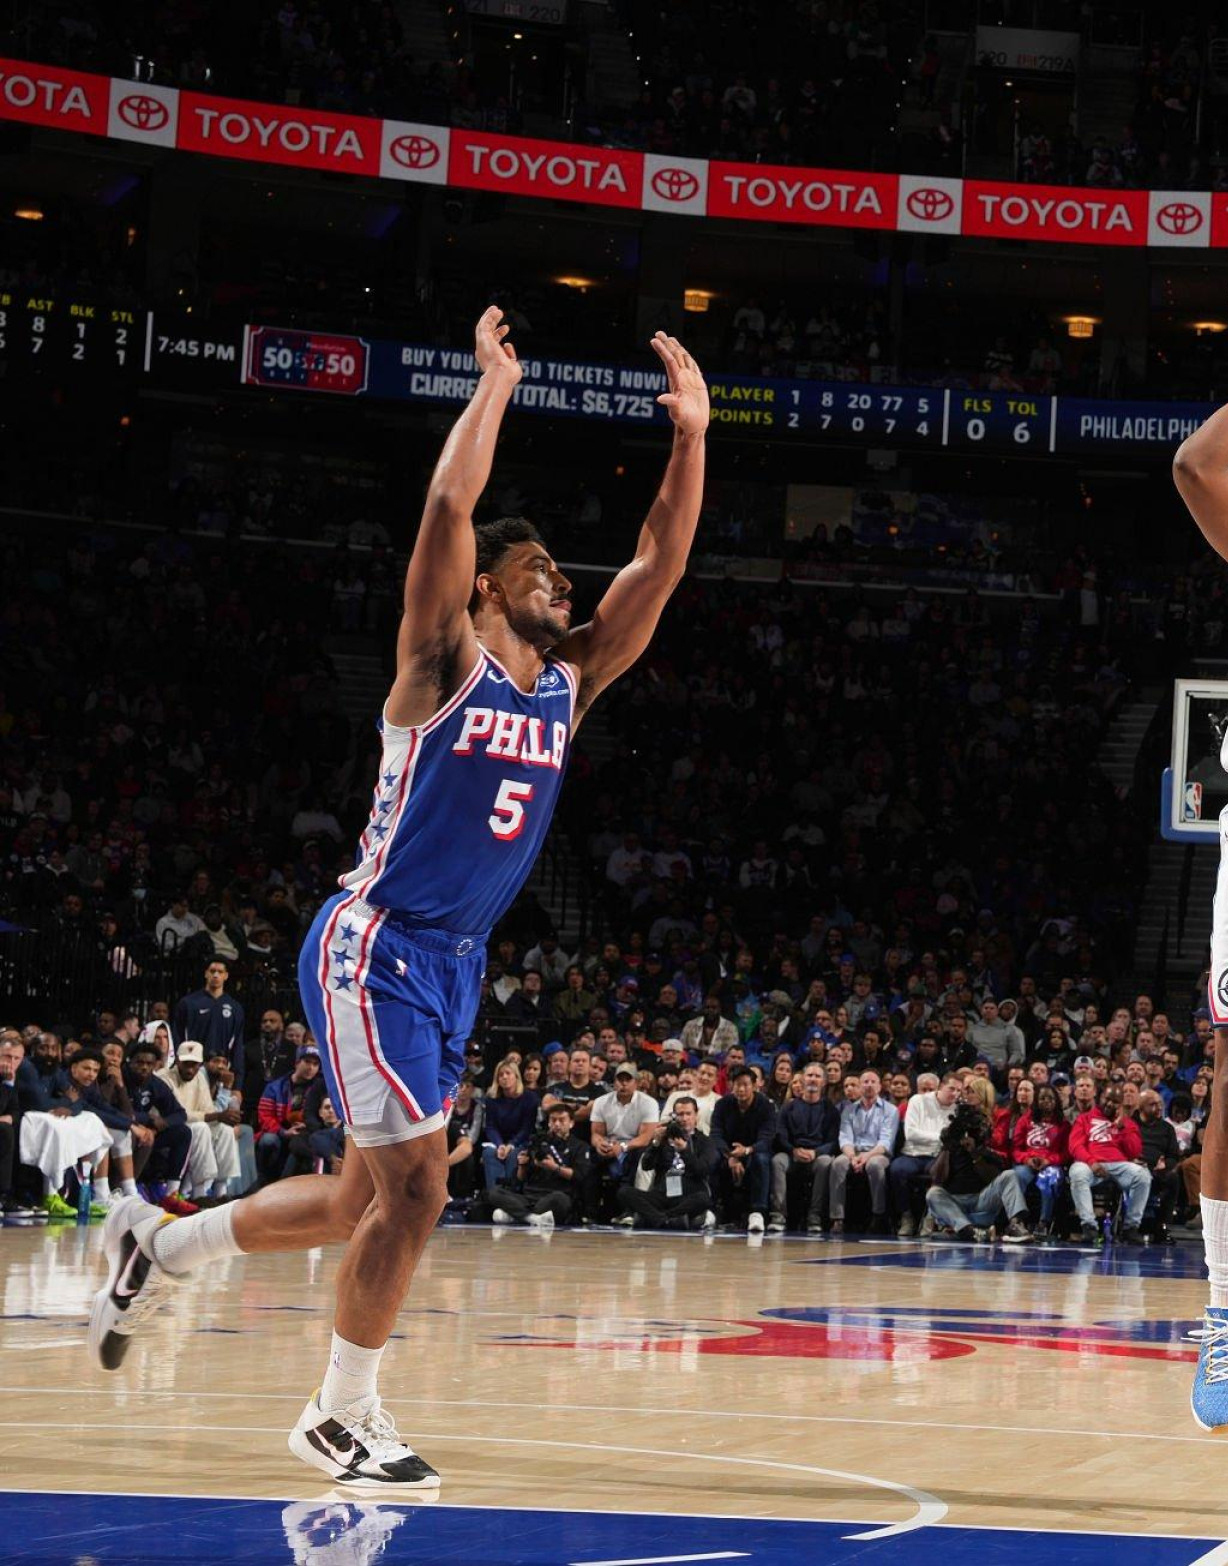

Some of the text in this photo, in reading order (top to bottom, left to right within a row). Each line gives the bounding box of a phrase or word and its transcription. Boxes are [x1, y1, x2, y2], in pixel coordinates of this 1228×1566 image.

[0, 73, 91, 118] OTA
[194, 108, 364, 160] TOYOTA
[465, 144, 627, 193] TOYOTA
[723, 175, 882, 215] TOYOTA
[977, 194, 1133, 233] TOYOTA
[26, 298, 54, 311] AST
[69, 304, 95, 318] BLK
[111, 310, 134, 324] STL
[31, 316, 46, 333] 8
[76, 322, 86, 339] 1
[115, 328, 128, 345] 2
[31, 337, 44, 354] 7
[72, 343, 85, 360] 2
[116, 350, 126, 366] 1
[158, 336, 235, 361] 7:45 PM
[263, 346, 293, 370] 50
[326, 353, 356, 376] 50
[401, 347, 436, 367] BUY
[547, 362, 614, 386] TICKETS
[619, 370, 667, 392] NOW!
[410, 372, 655, 418] CURRE TOTAL: $6,725
[710, 385, 929, 414] PLAYER 1 8 20 77 5
[962, 398, 1038, 417] FLS TOL
[710, 407, 929, 436] POINTS 2 7 0 7 4
[966, 418, 1030, 444] 0 6
[1079, 415, 1201, 441] PHILADELPHI
[488, 779, 534, 841] 5
